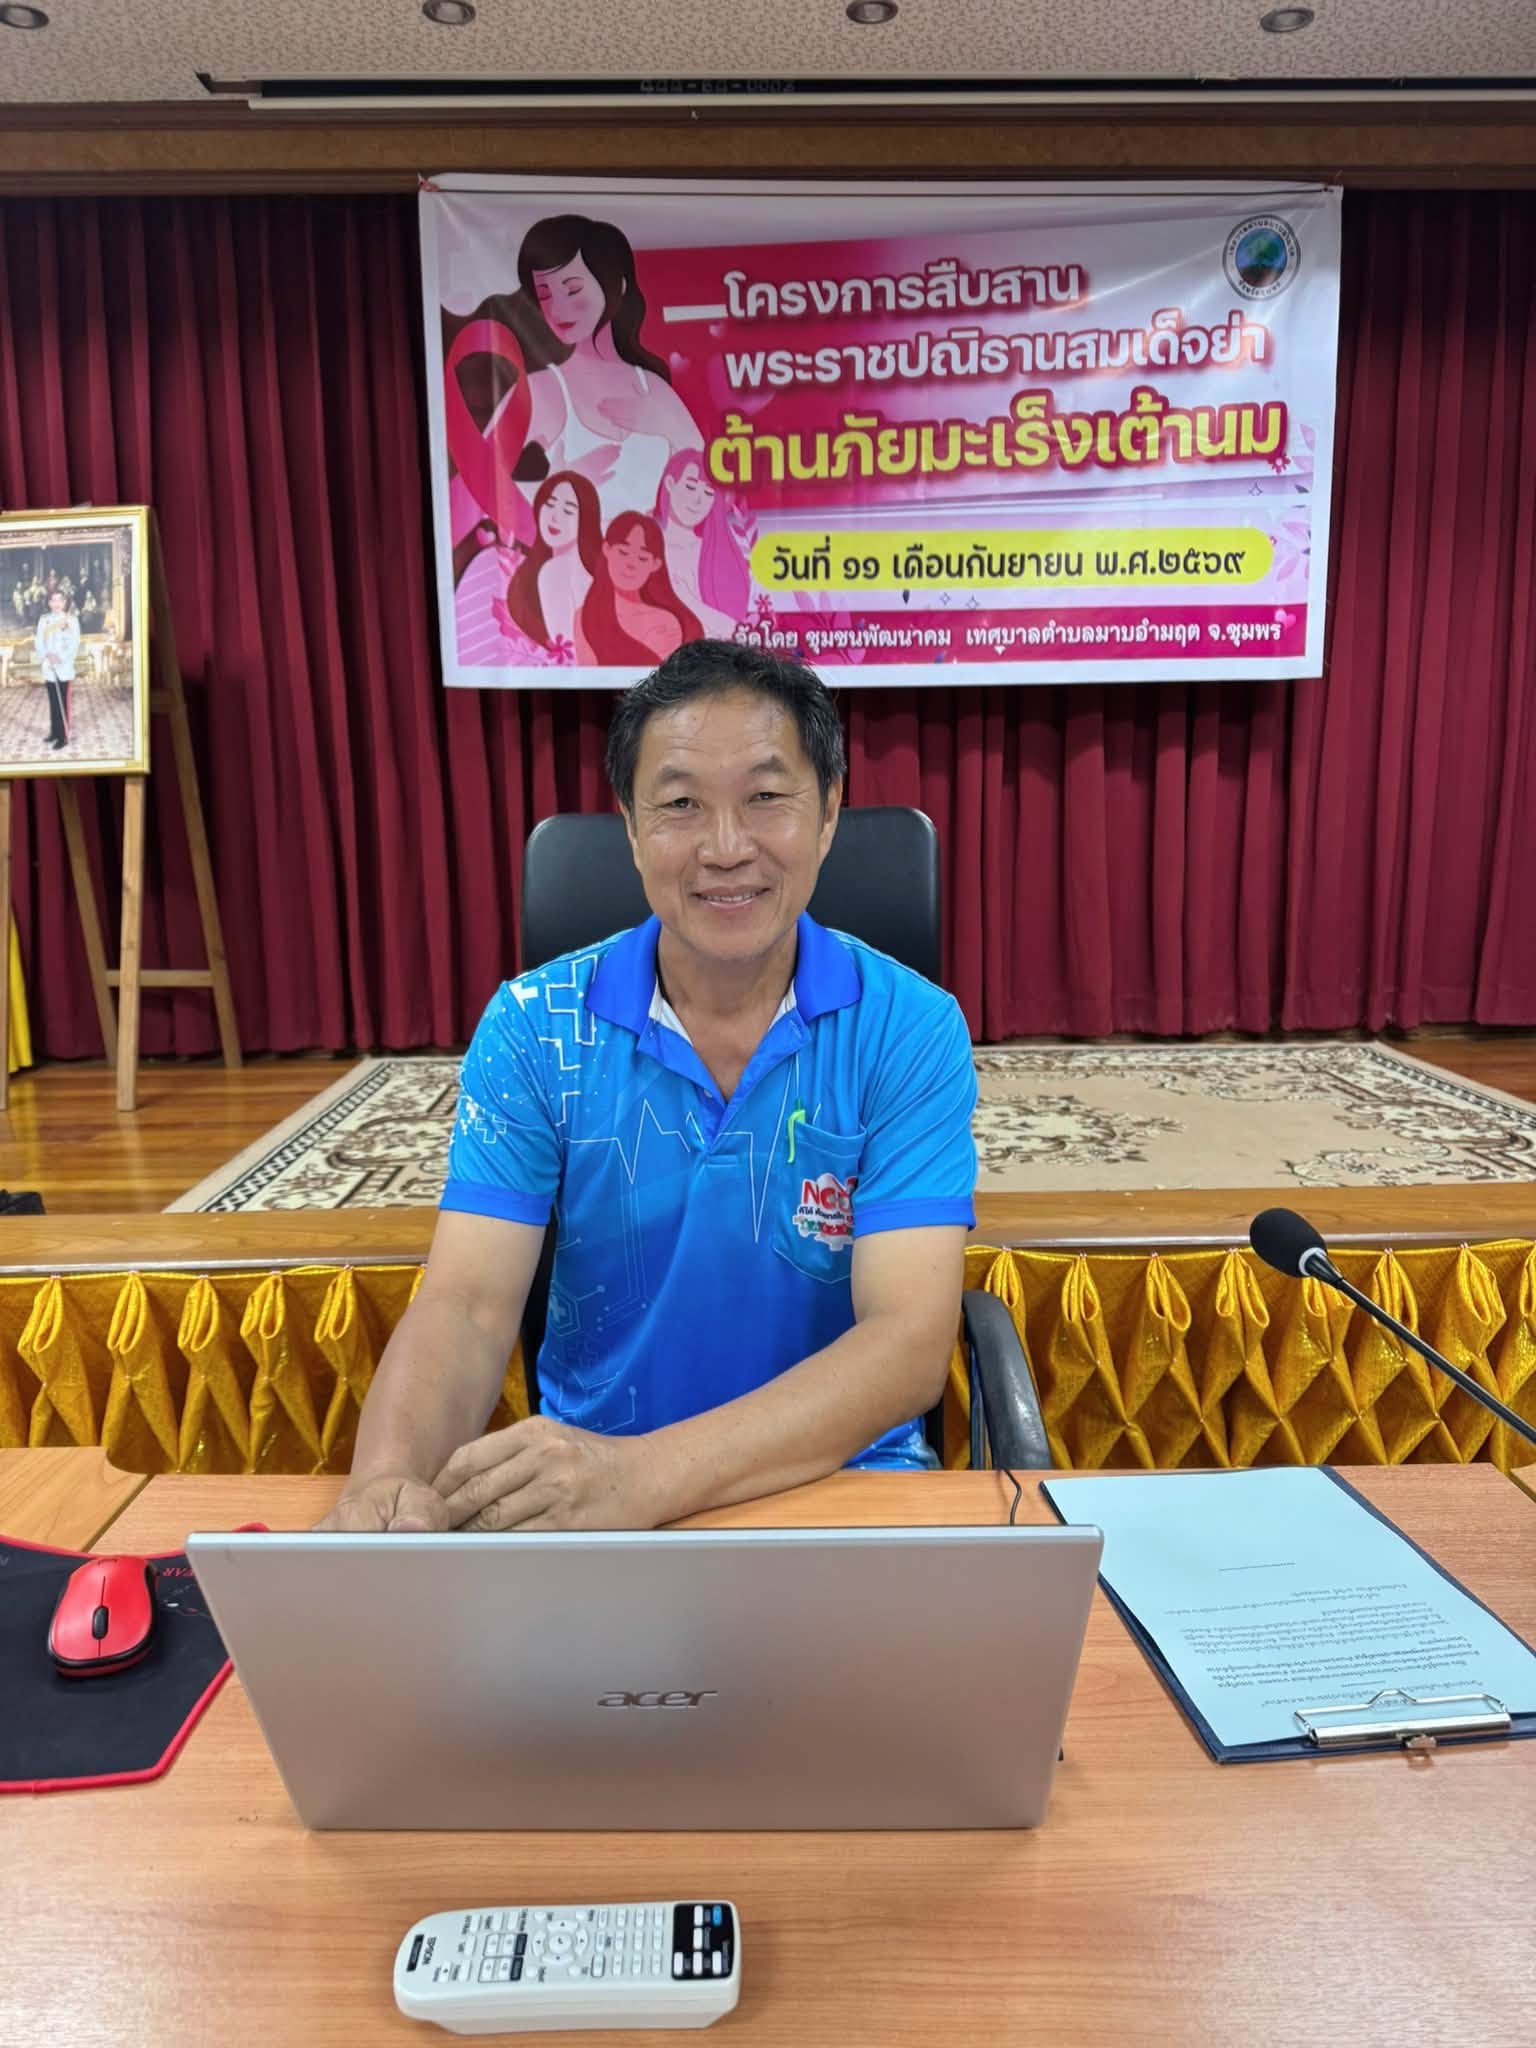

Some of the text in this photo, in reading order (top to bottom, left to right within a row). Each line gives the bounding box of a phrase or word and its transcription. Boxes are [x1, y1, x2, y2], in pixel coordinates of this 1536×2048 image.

[724, 261, 1080, 318] โครงการสืบสาน
[726, 311, 1266, 388] พระราชปณิธานสมเด็จย่า
[709, 392, 1282, 484] ต้านภัยมะเร็งเต้านม
[773, 536, 1246, 581] วันที่ ๑๑ เดือนกันยายน พ.ศ.๒๕๖๙
[735, 620, 798, 648] จัดโดย
[805, 623, 951, 655] ชุมชนพัฒนาคม
[1208, 622, 1282, 647] จ.ชุมพร
[597, 1690, 719, 1708] acer
